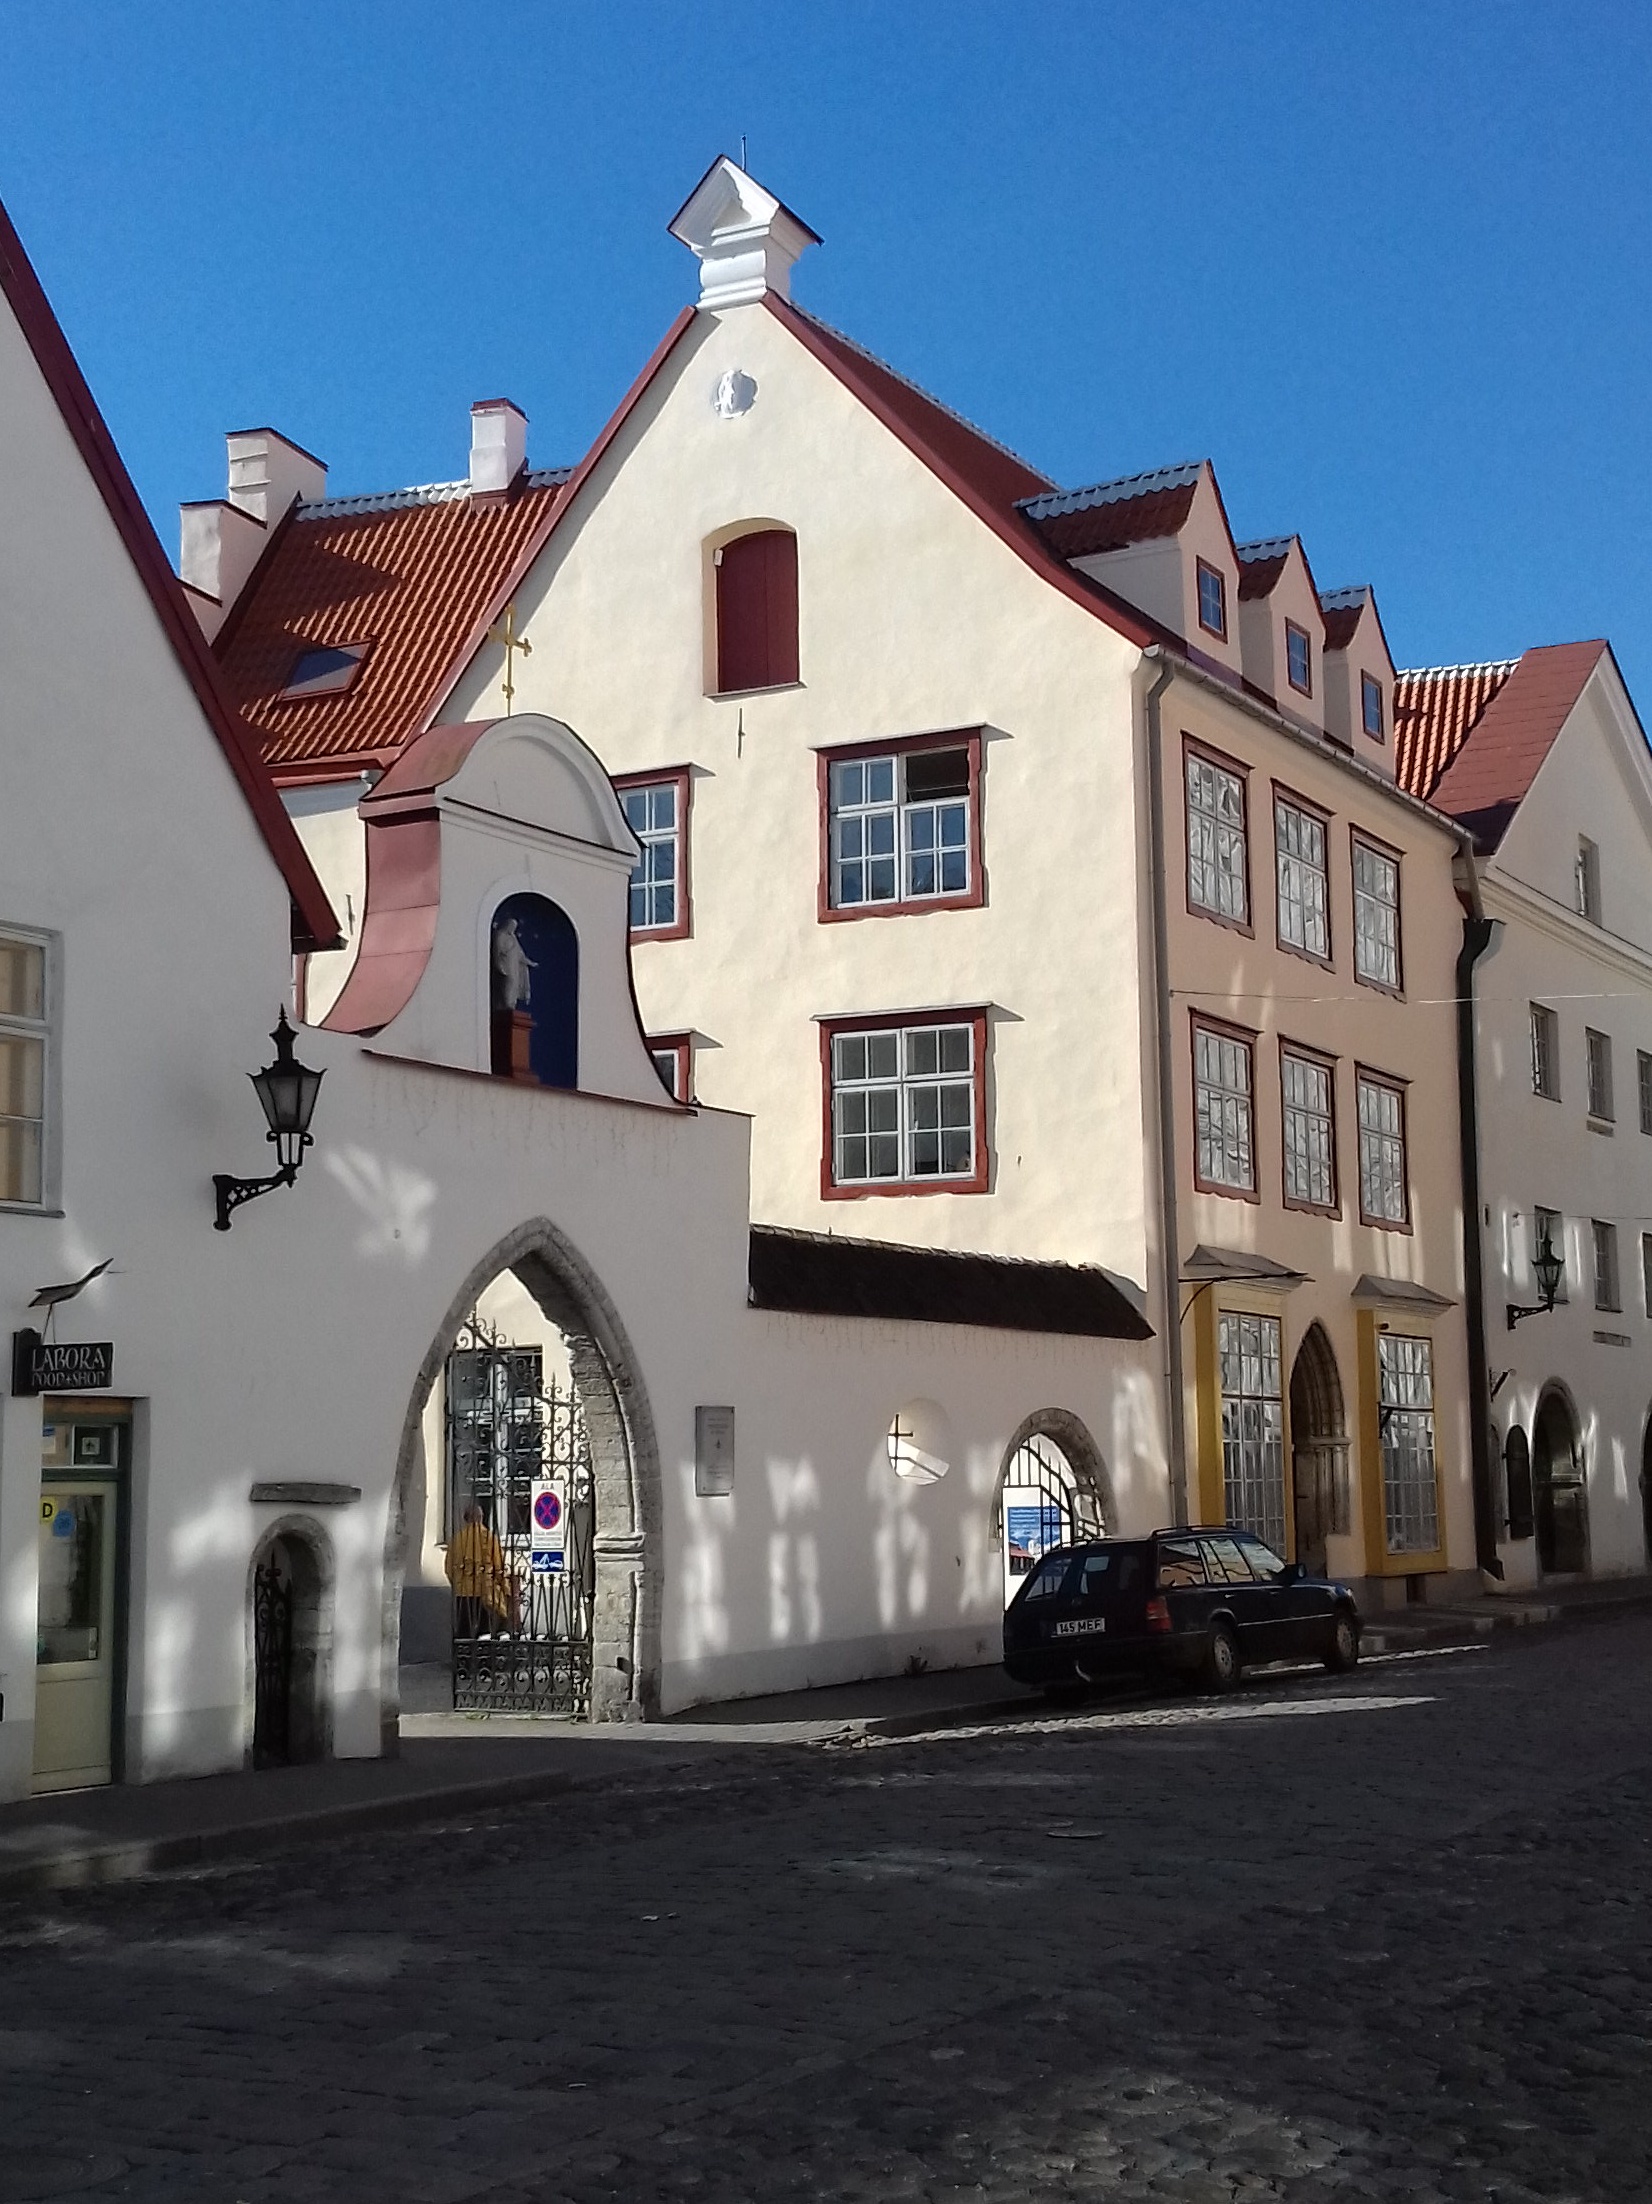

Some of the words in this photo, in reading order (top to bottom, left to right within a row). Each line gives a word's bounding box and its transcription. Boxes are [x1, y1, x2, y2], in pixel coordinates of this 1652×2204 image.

[32, 1347, 105, 1371] LABORA
[1060, 1621, 1075, 1633] 145
[1077, 1619, 1101, 1632] MEF
